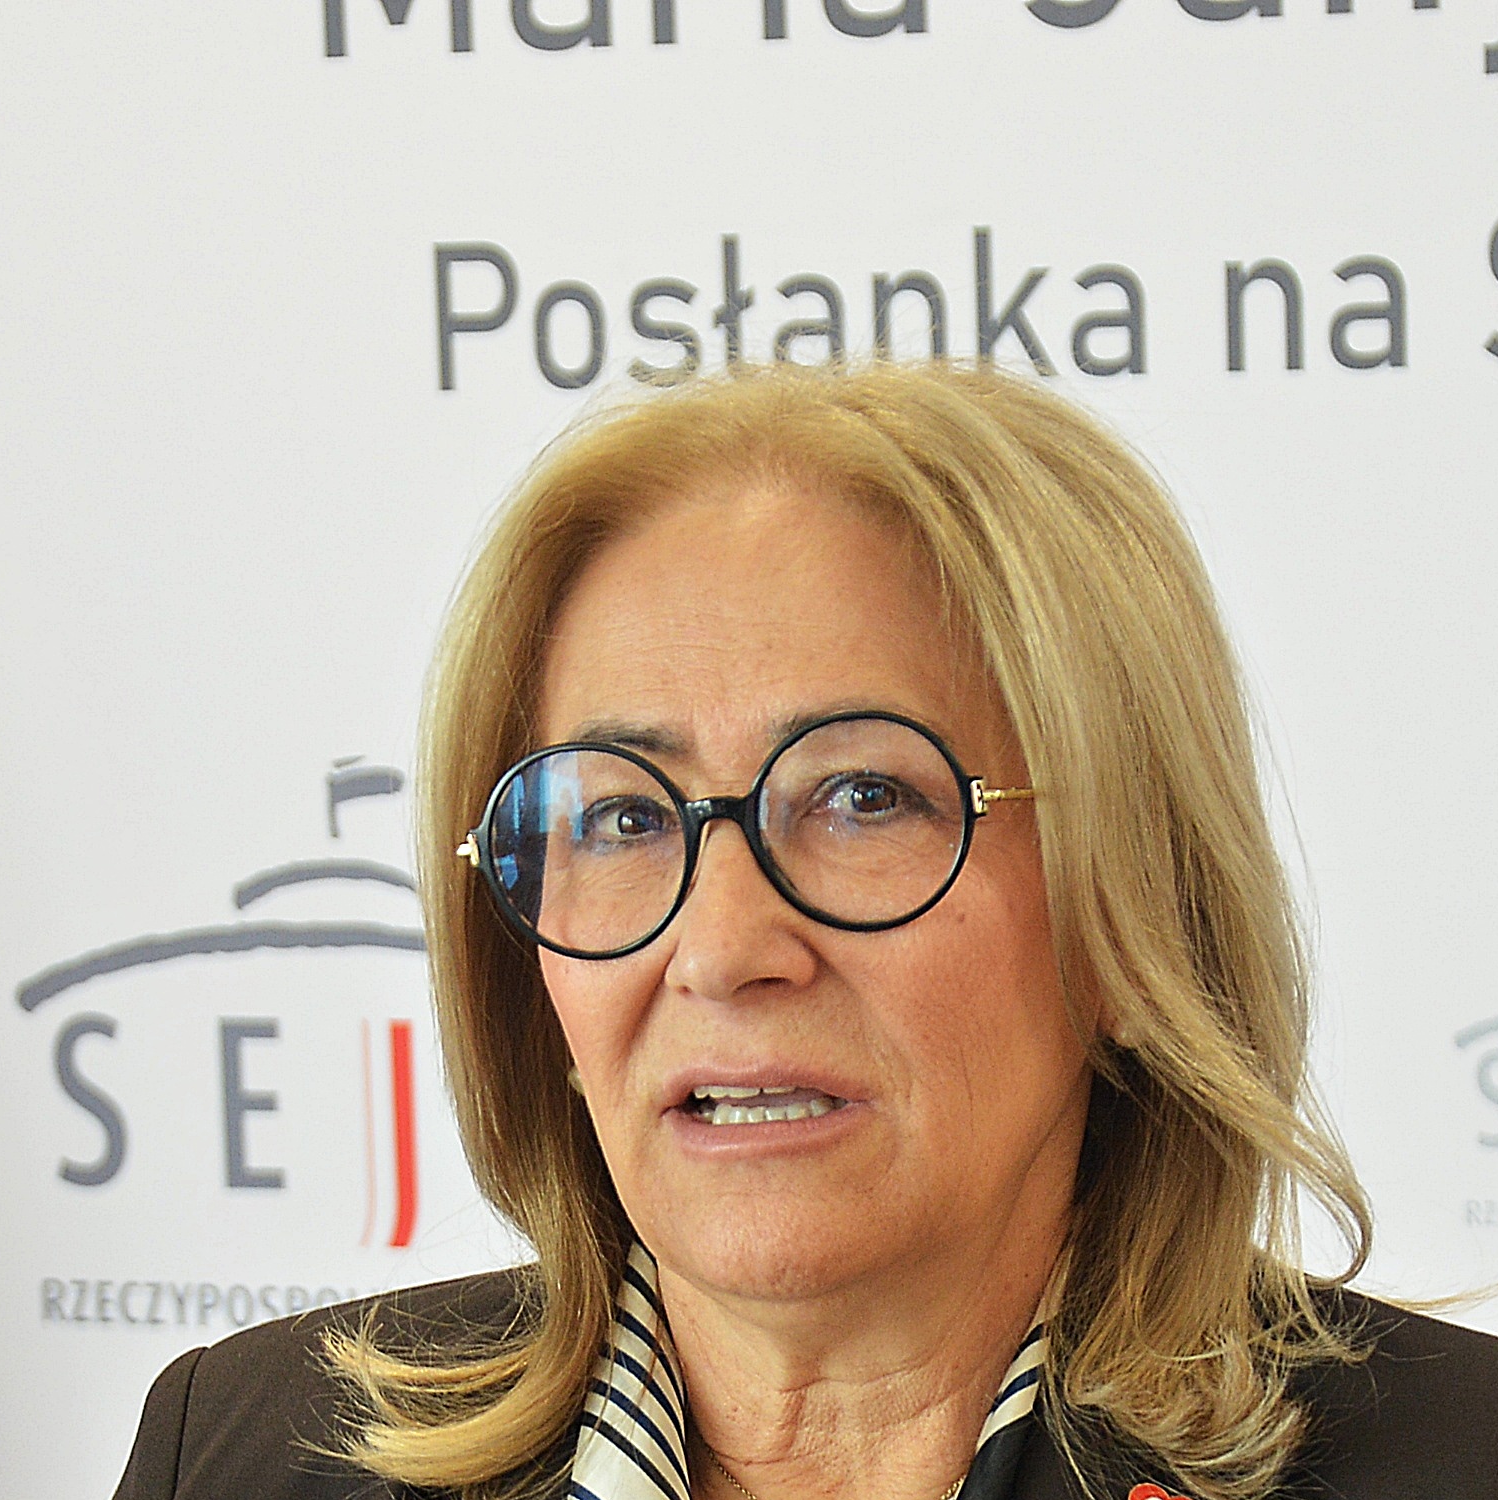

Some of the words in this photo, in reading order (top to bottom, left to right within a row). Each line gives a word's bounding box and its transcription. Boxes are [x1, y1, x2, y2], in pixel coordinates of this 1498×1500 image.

[433, 224, 1149, 391] Posłanka
[1225, 255, 1409, 372] na
[53, 1011, 419, 1248] SEJ
